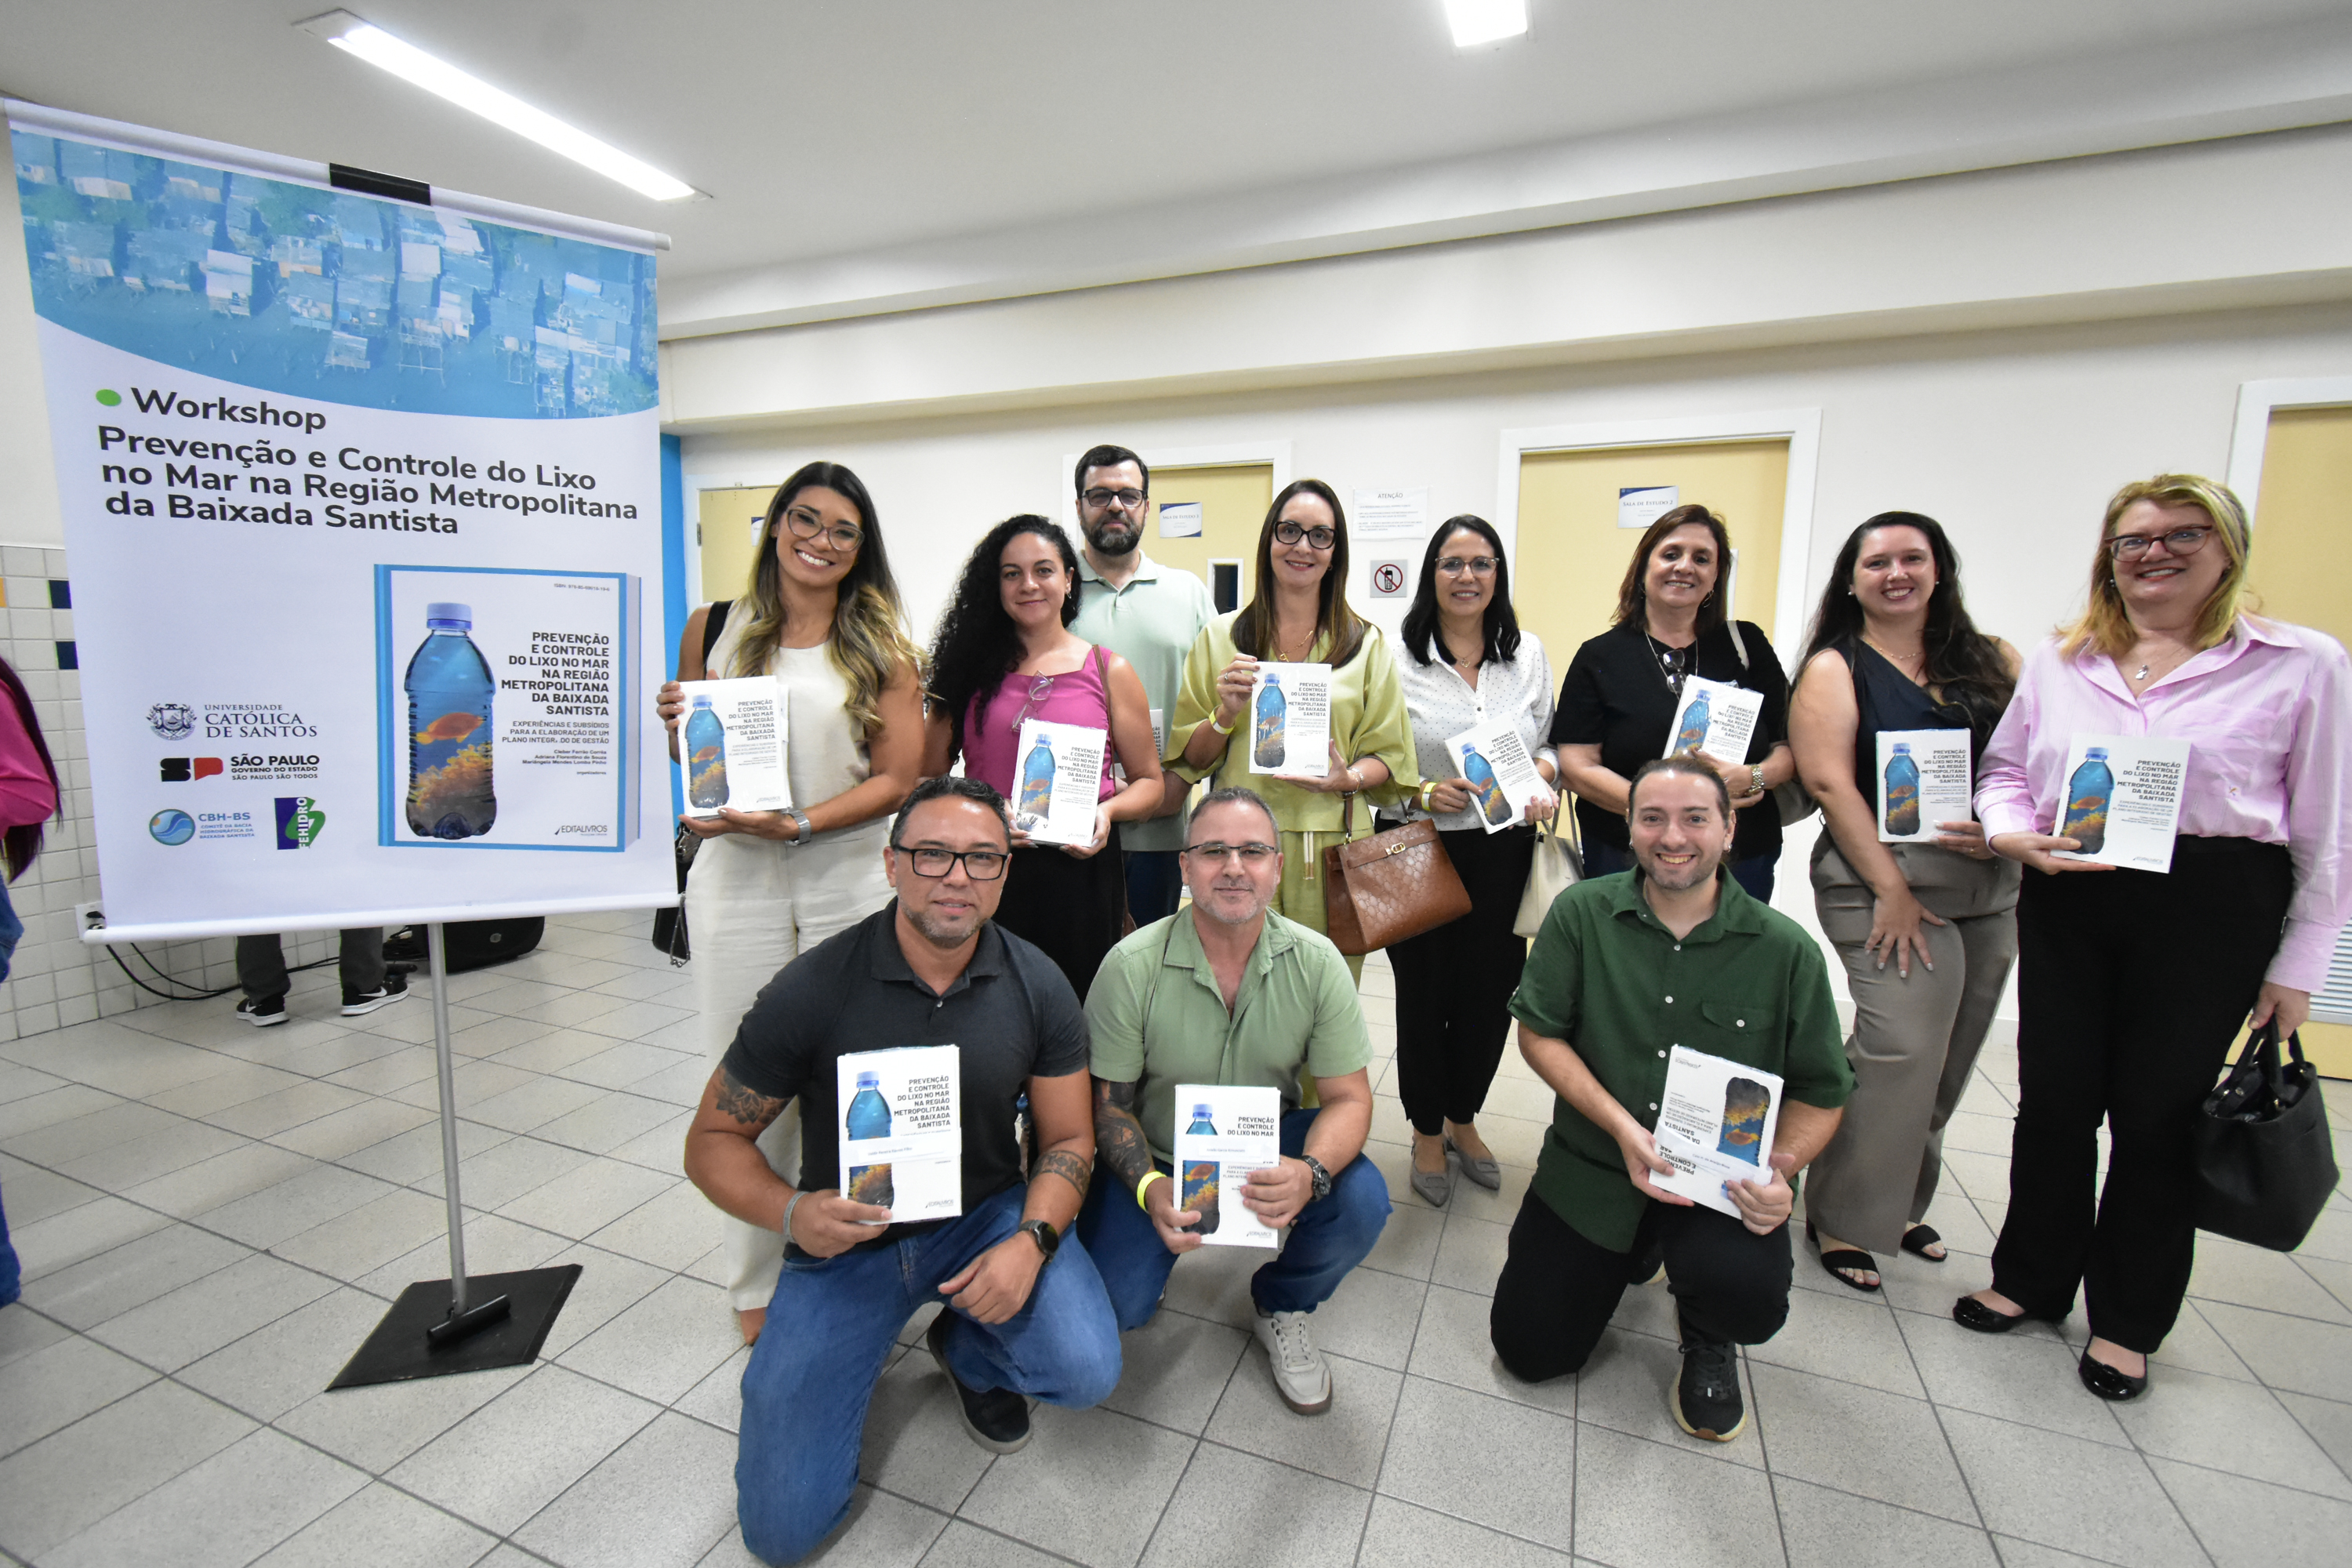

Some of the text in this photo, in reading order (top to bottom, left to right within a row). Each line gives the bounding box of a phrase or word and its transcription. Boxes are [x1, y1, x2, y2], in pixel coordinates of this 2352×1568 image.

[131, 387, 326, 434] Workshop
[99, 425, 595, 490] Prevenção e Controle do Lixo
[103, 463, 637, 519] no Mar na Região Metropolitana
[106, 491, 458, 534] da Baixada Santista
[532, 632, 609, 646] PREVENÇÃO
[532, 644, 609, 657] E CONTROLE
[509, 655, 609, 668] DO LIXO NO MAR
[542, 669, 609, 680] NA REGIÃO
[501, 680, 609, 692] METROPOLITANA
[532, 693, 609, 704] DA BAIXADA
[546, 706, 609, 716] SANTISTA
[206, 711, 303, 725] CATÓLICA
[206, 726, 231, 738] DE
[240, 726, 317, 738] SANTOS
[1492, 731, 1515, 743] PREVENÇÃO
[231, 753, 320, 766] SÃO PAULO
[1491, 747, 1522, 763] METROPOLITANA
[1058, 766, 1097, 774] METROPOLITANA
[2117, 782, 2177, 791] METROPOLITANA
[199, 812, 250, 822] CBH-BS
[296, 797, 310, 849] FEHIDRO
[909, 1075, 949, 1085] PREVENÇÃO
[914, 1083, 949, 1092] CONTROLE
[926, 1097, 950, 1106] REGIÃO
[894, 1105, 950, 1116] METROPOLITANA
[921, 1113, 950, 1121] BAIXADA
[918, 1120, 950, 1129] SANTISTA
[1664, 1121, 1695, 1136] SANTISTA
[1659, 1151, 1691, 1167] CONTROLE
